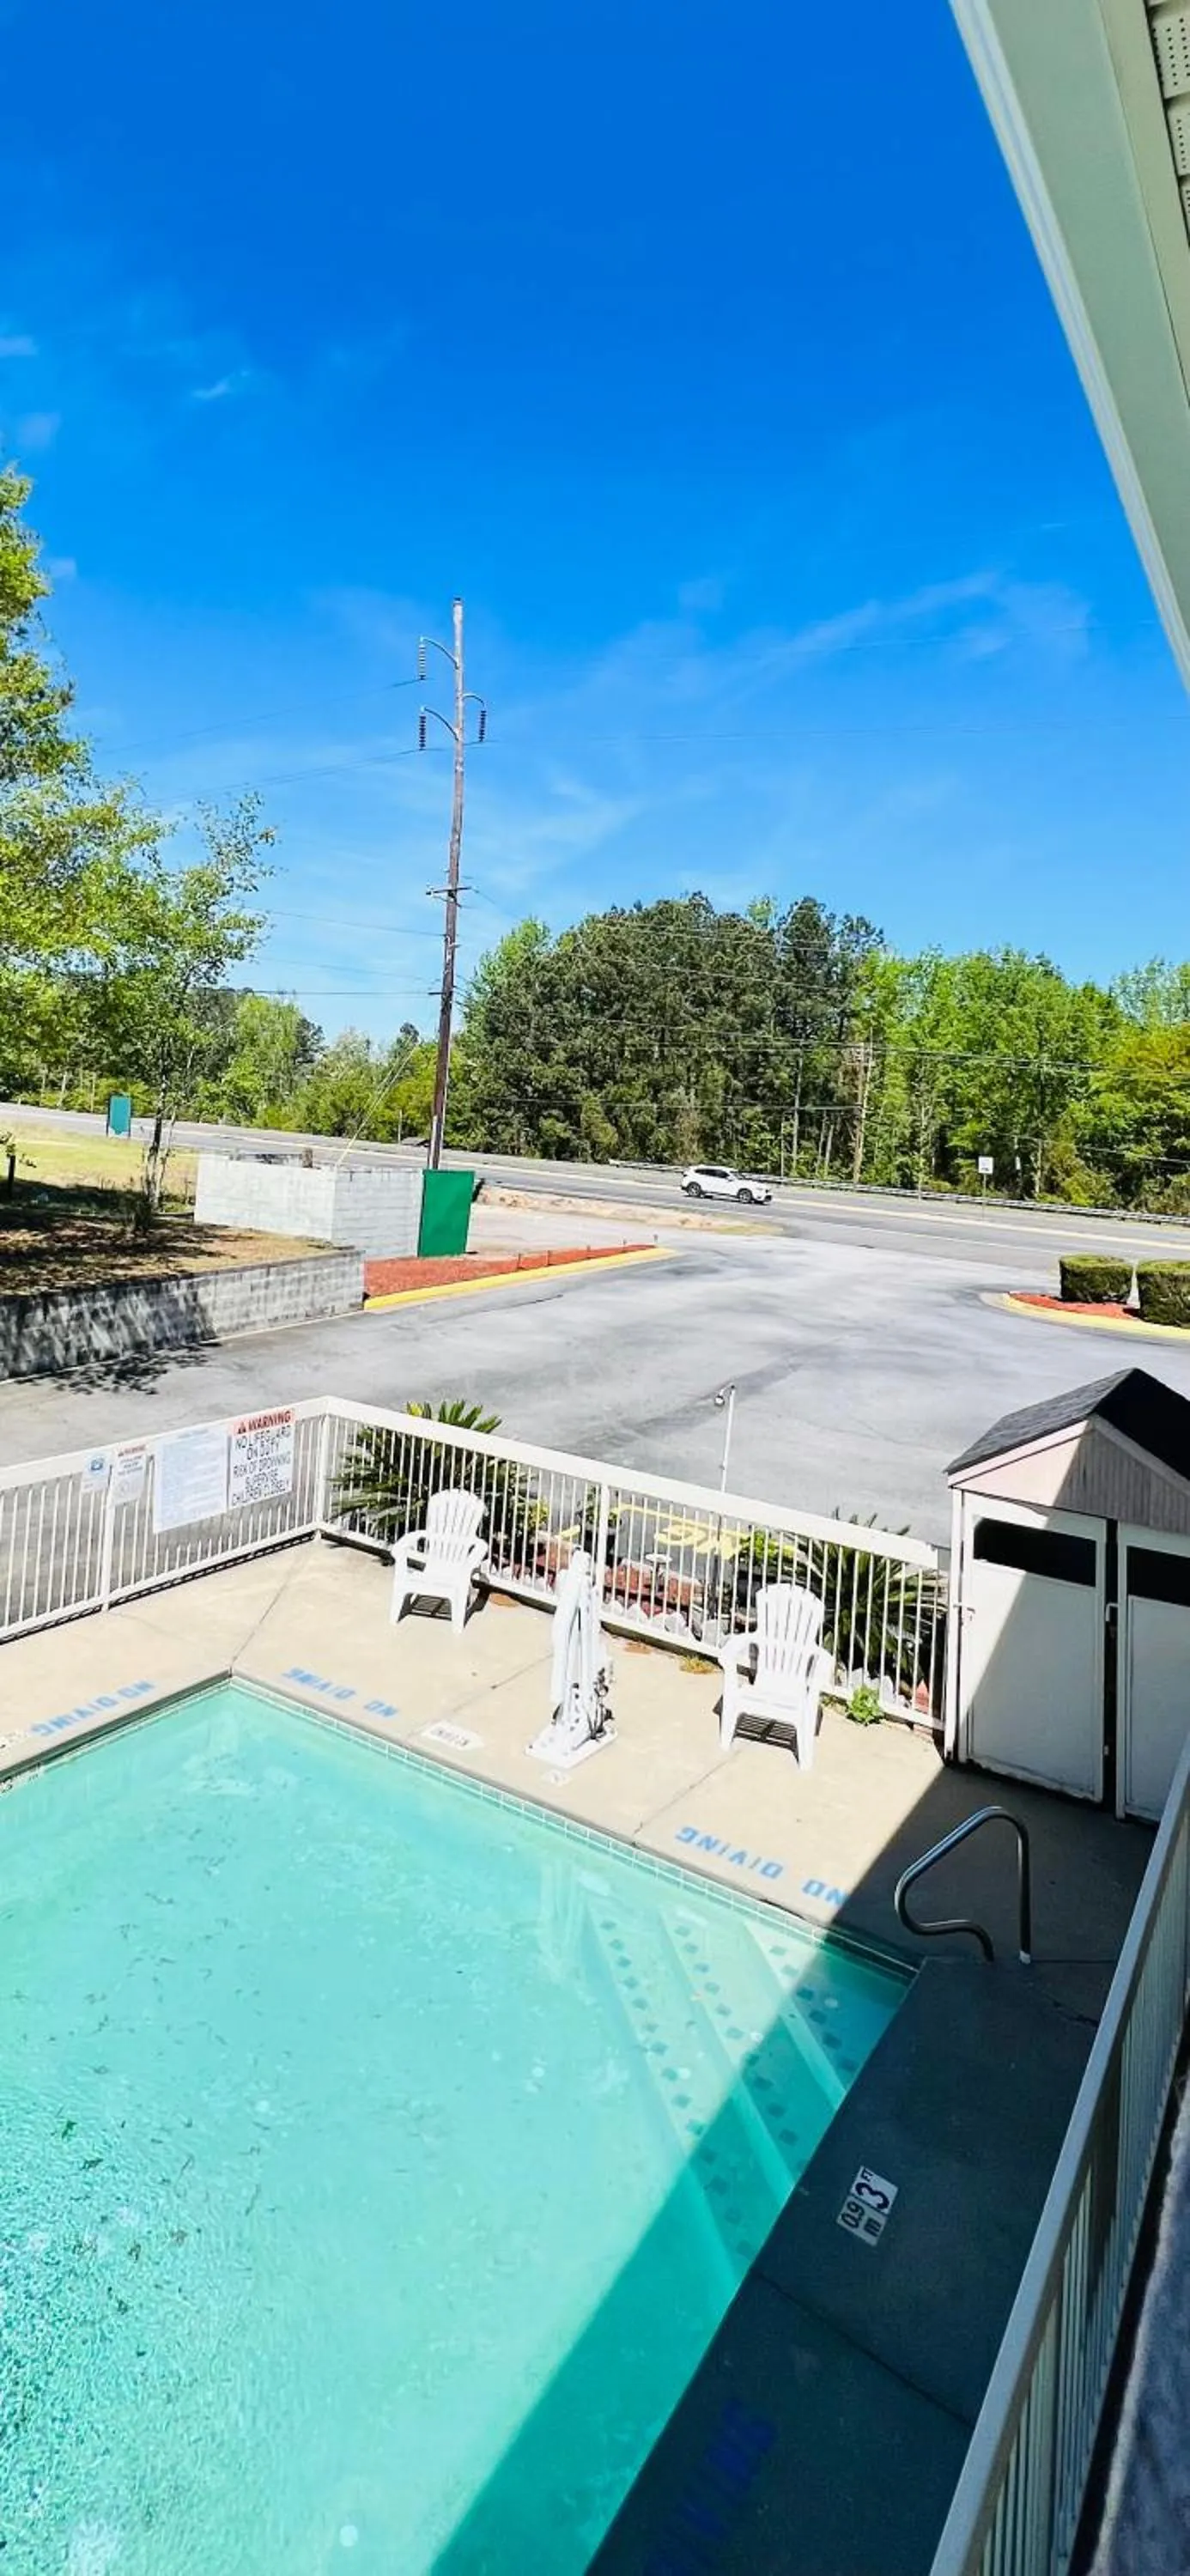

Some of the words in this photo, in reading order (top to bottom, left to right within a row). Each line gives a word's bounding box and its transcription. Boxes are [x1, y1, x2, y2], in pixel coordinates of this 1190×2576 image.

[248, 1411, 291, 1431] WARNING
[675, 1826, 784, 1880] DIVING
[802, 1879, 851, 1906] NO
[855, 2182, 889, 2209] 3
